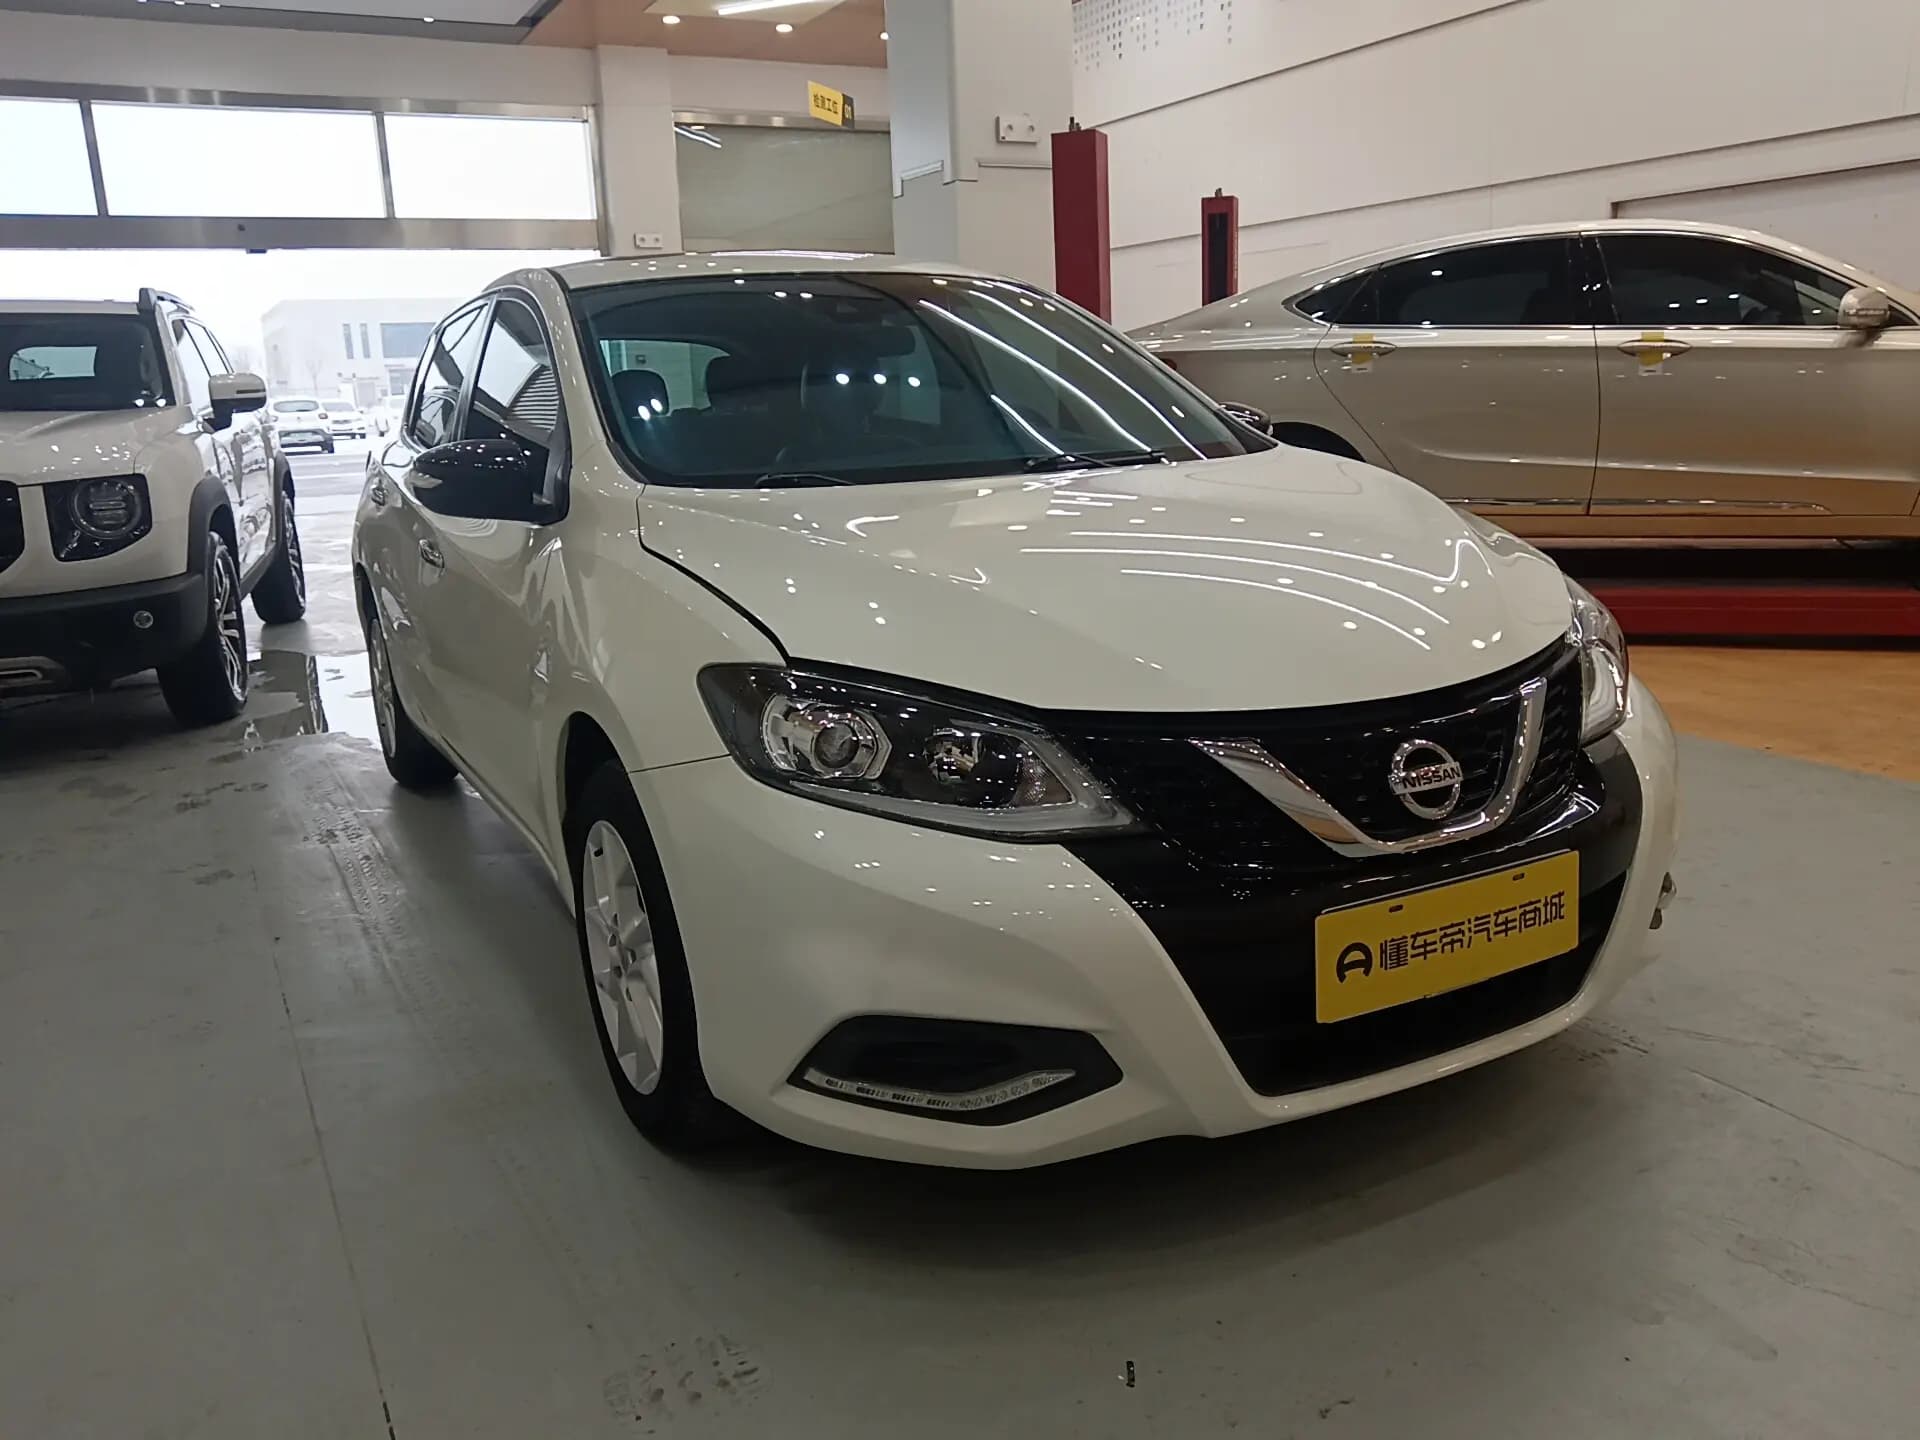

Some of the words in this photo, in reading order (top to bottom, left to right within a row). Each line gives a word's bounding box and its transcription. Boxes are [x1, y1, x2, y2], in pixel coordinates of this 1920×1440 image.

[1402, 766, 1461, 788] NISSAN
[1380, 890, 1565, 971] 懂车帝汽车商城
